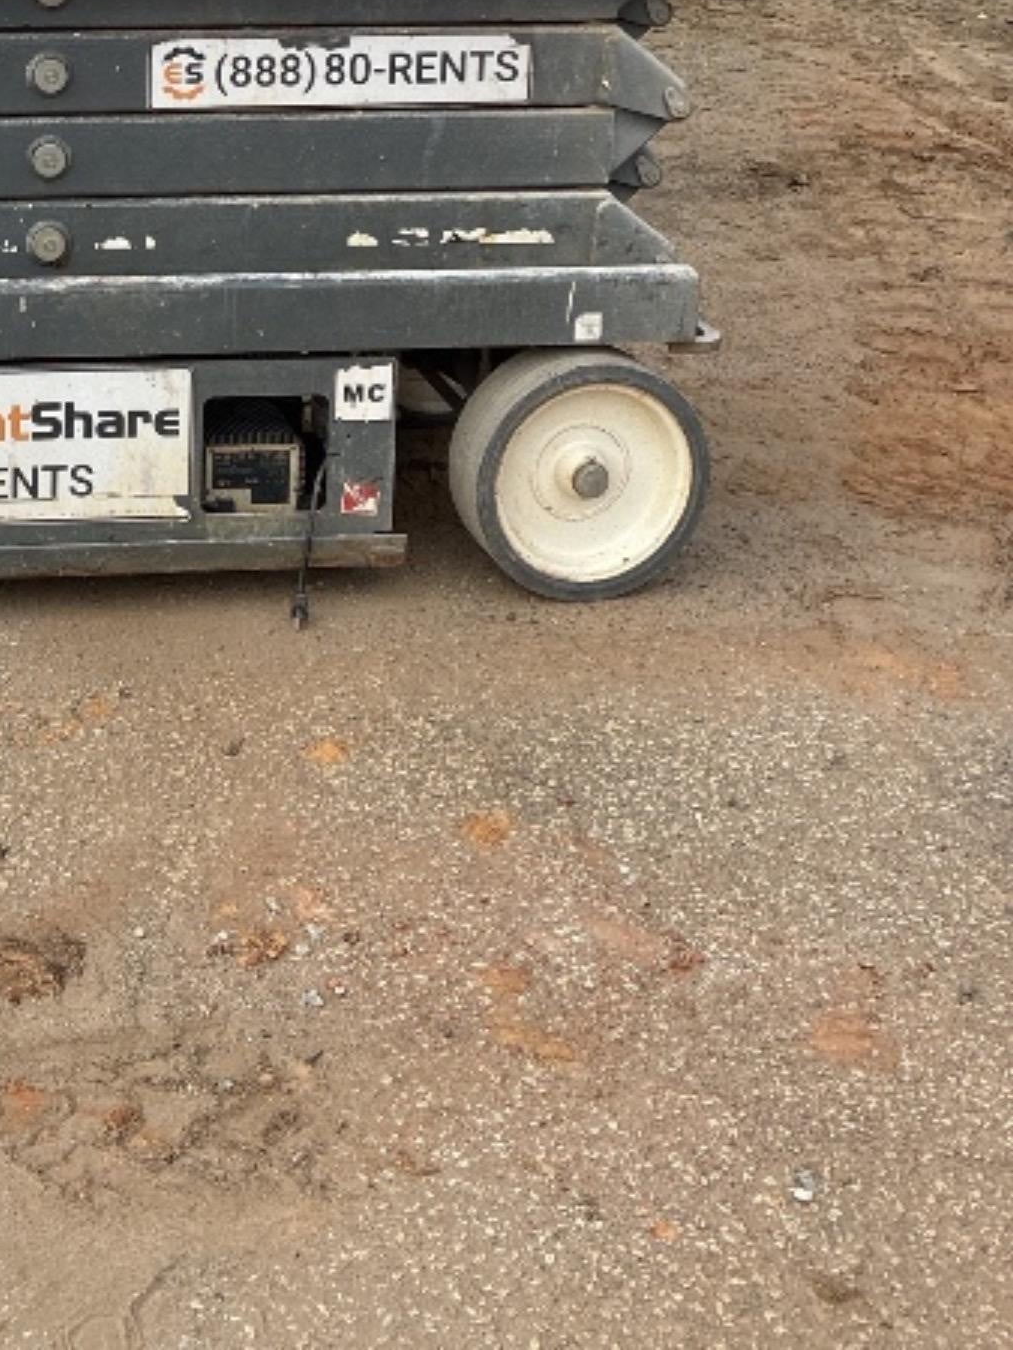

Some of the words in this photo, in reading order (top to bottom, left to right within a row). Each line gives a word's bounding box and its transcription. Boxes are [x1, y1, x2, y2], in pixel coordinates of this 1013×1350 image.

[215, 52, 316, 96] (888)
[325, 50, 519, 85] 80-RENTS
[343, 384, 386, 403] MC
